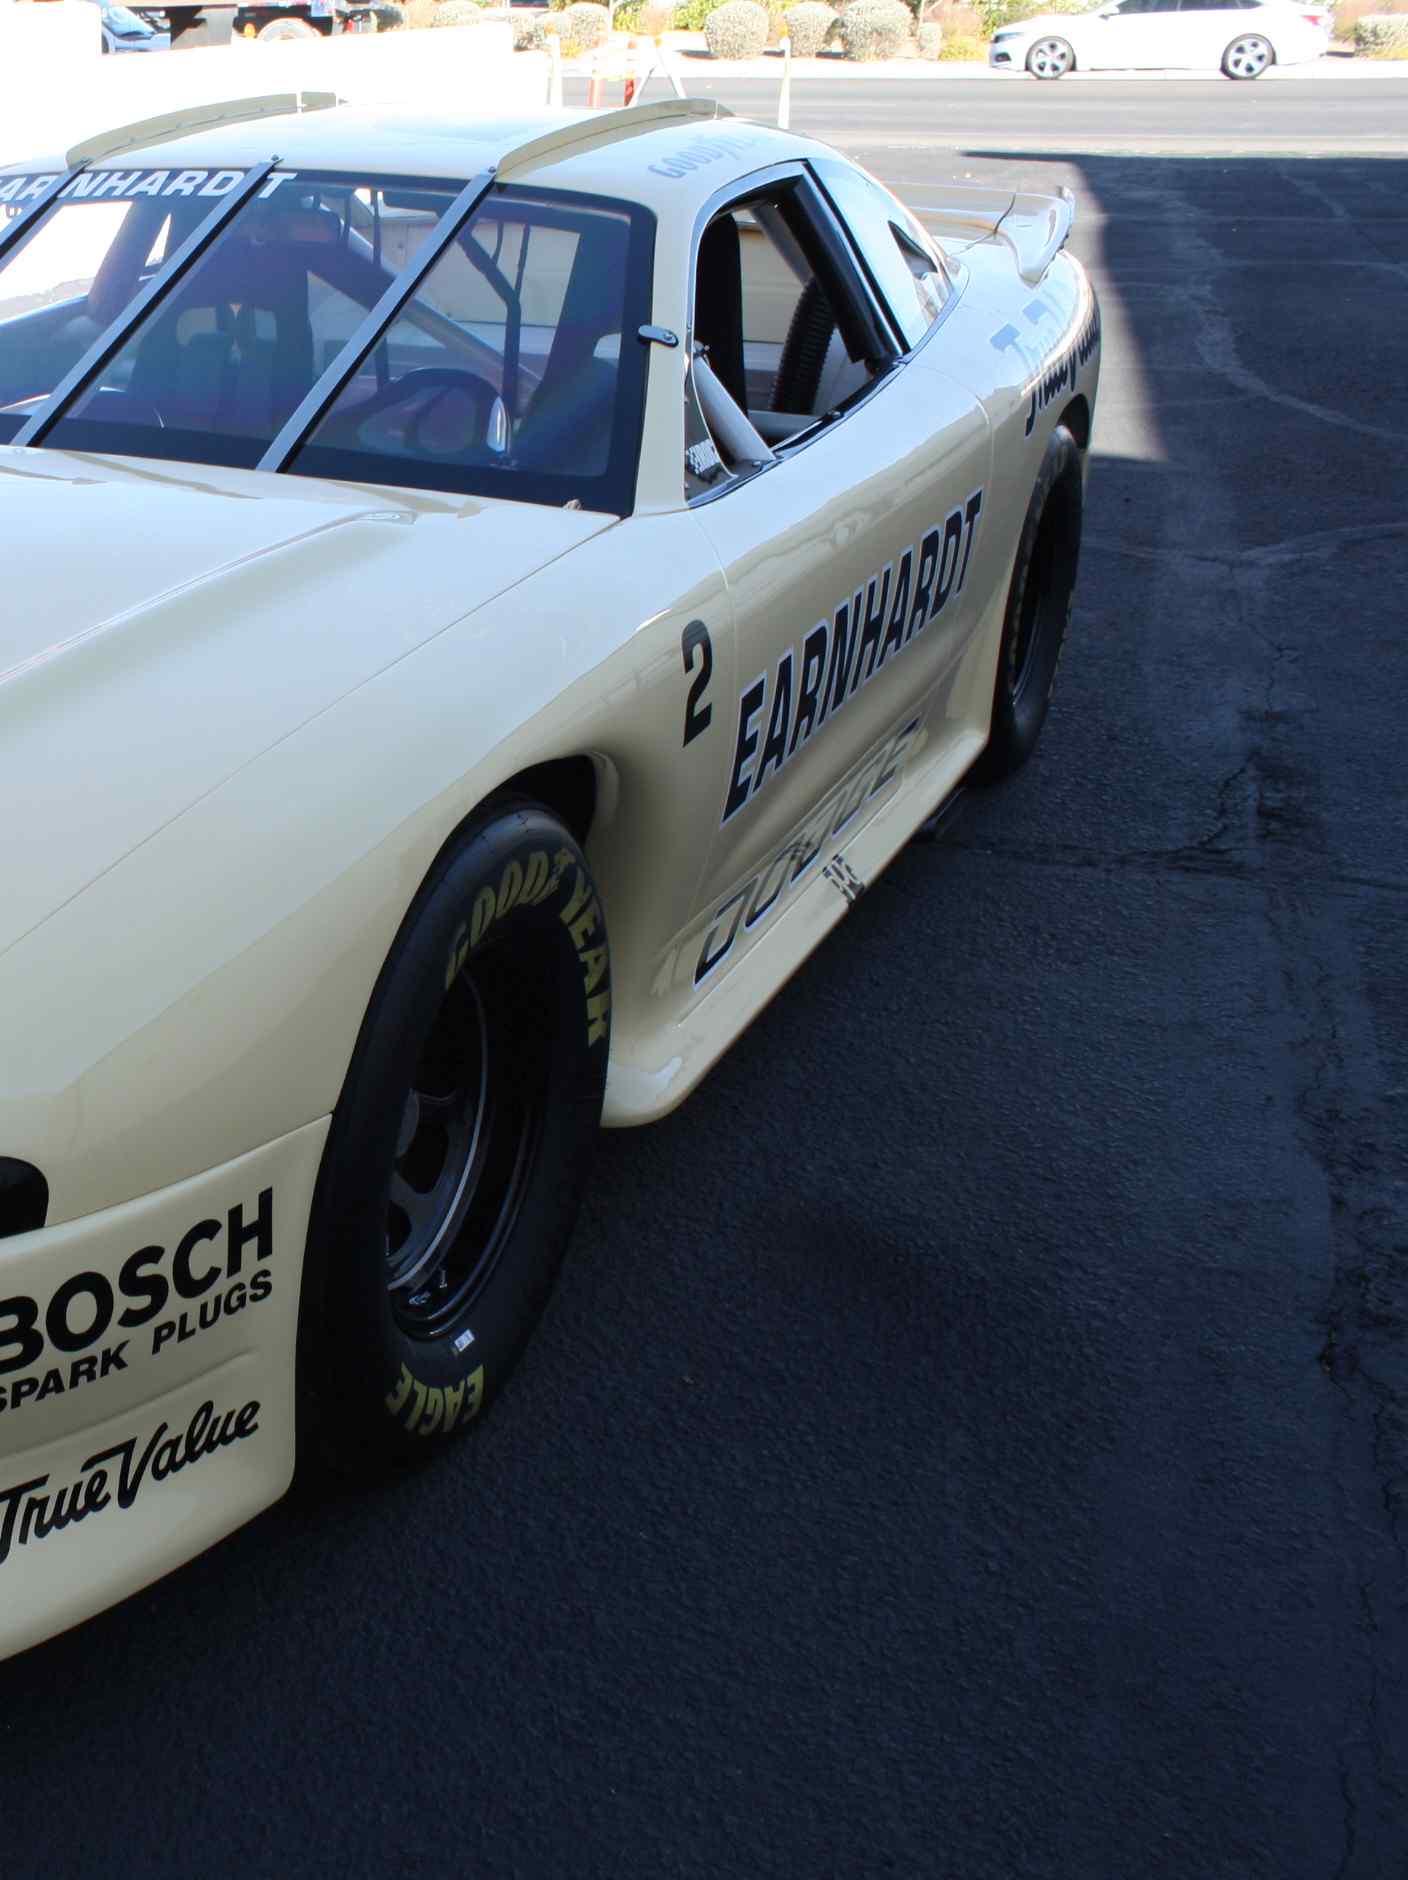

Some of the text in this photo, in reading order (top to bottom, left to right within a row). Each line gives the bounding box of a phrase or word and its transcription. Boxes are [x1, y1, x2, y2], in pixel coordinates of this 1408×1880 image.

[681, 619, 713, 748] 2
[719, 488, 984, 830] EARNHARDT
[444, 848, 610, 1050] GOODYEAR
[151, 1267, 275, 1356] PLUGS
[81, 1399, 261, 1509] Value
[384, 1359, 487, 1438] EAGLE
